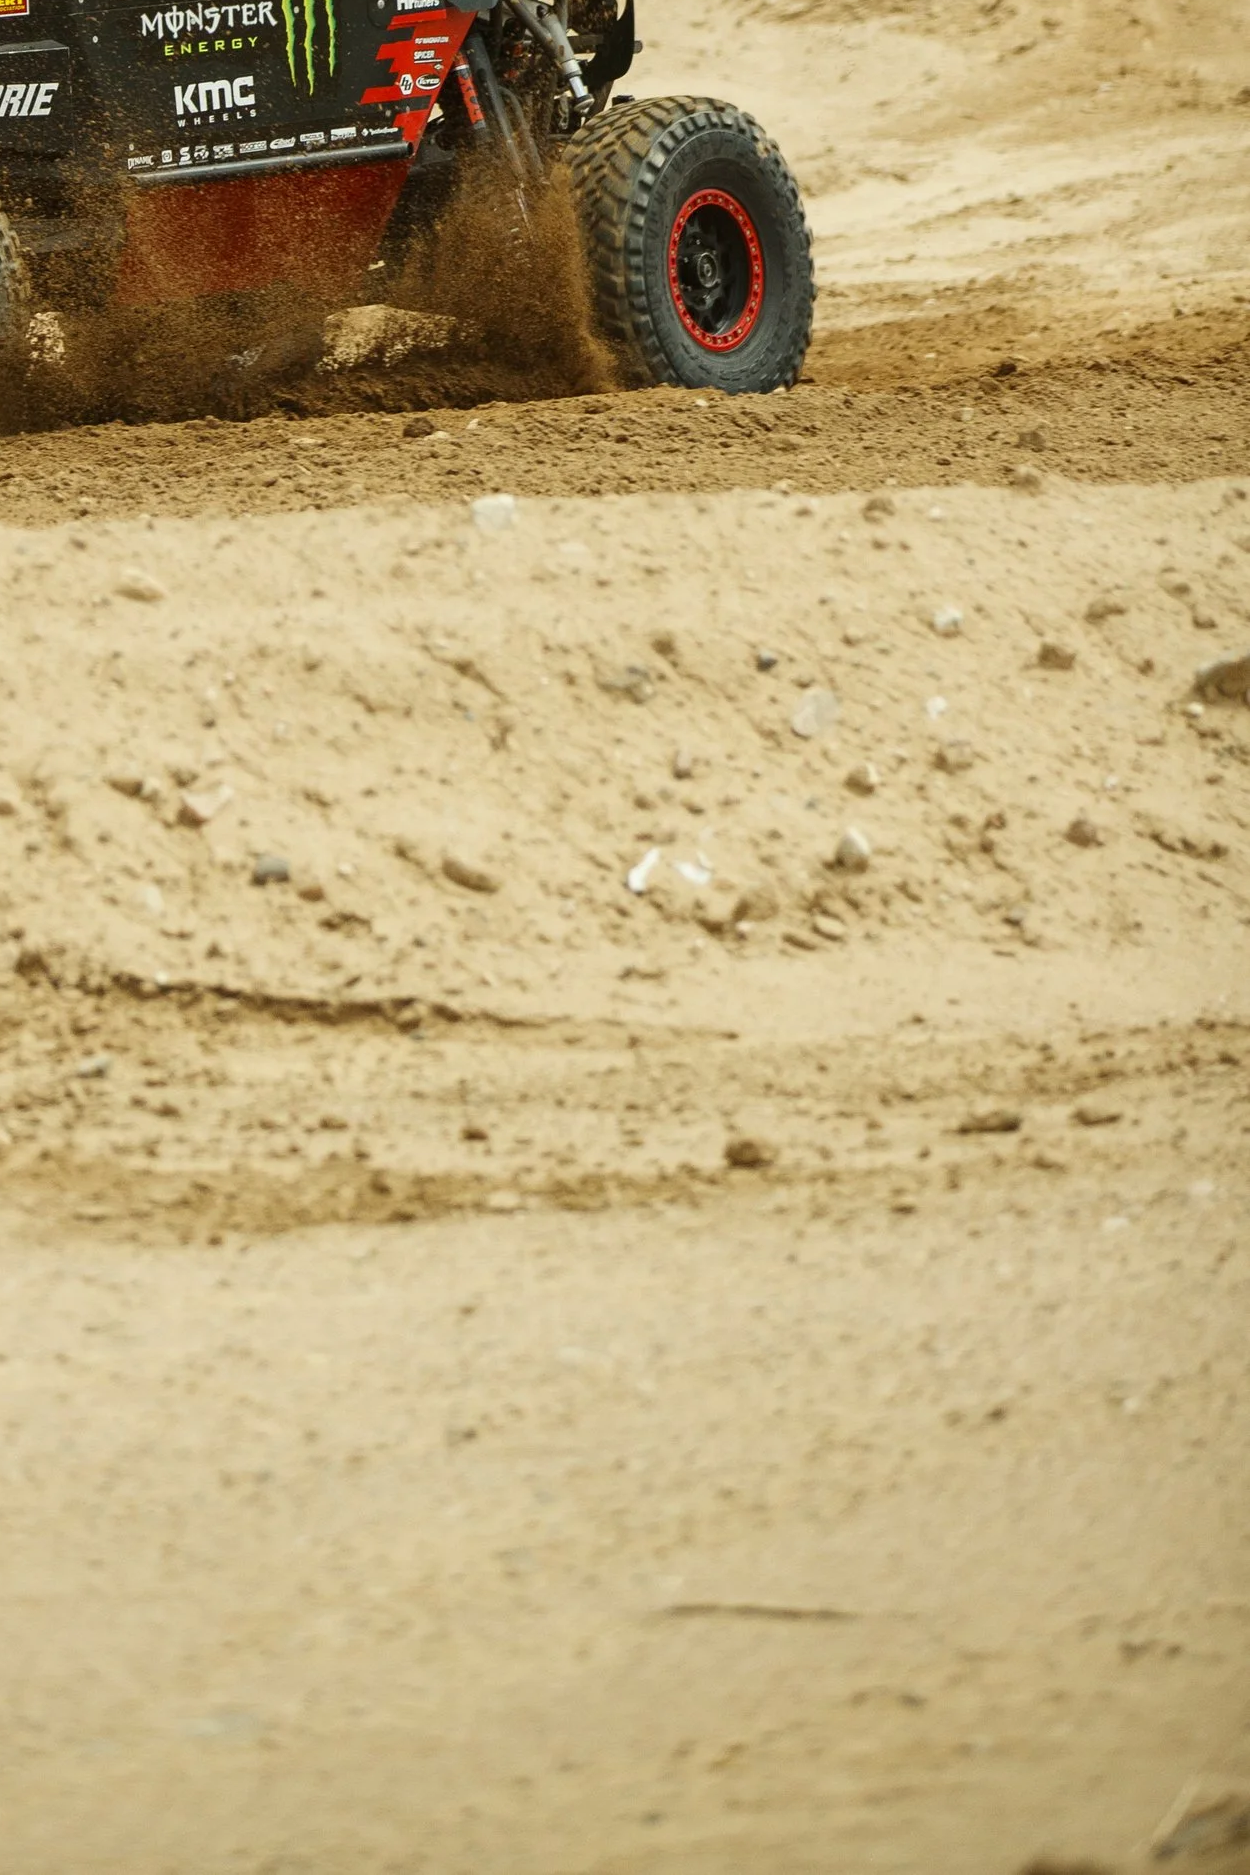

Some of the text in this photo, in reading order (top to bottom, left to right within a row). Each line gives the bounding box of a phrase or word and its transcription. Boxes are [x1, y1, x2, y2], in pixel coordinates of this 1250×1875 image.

[140, 1, 279, 40] MONSTER
[164, 36, 259, 56] ENERGY
[413, 50, 436, 60] SPICER
[174, 75, 256, 116] KMC
[178, 109, 257, 128] WHEELS
